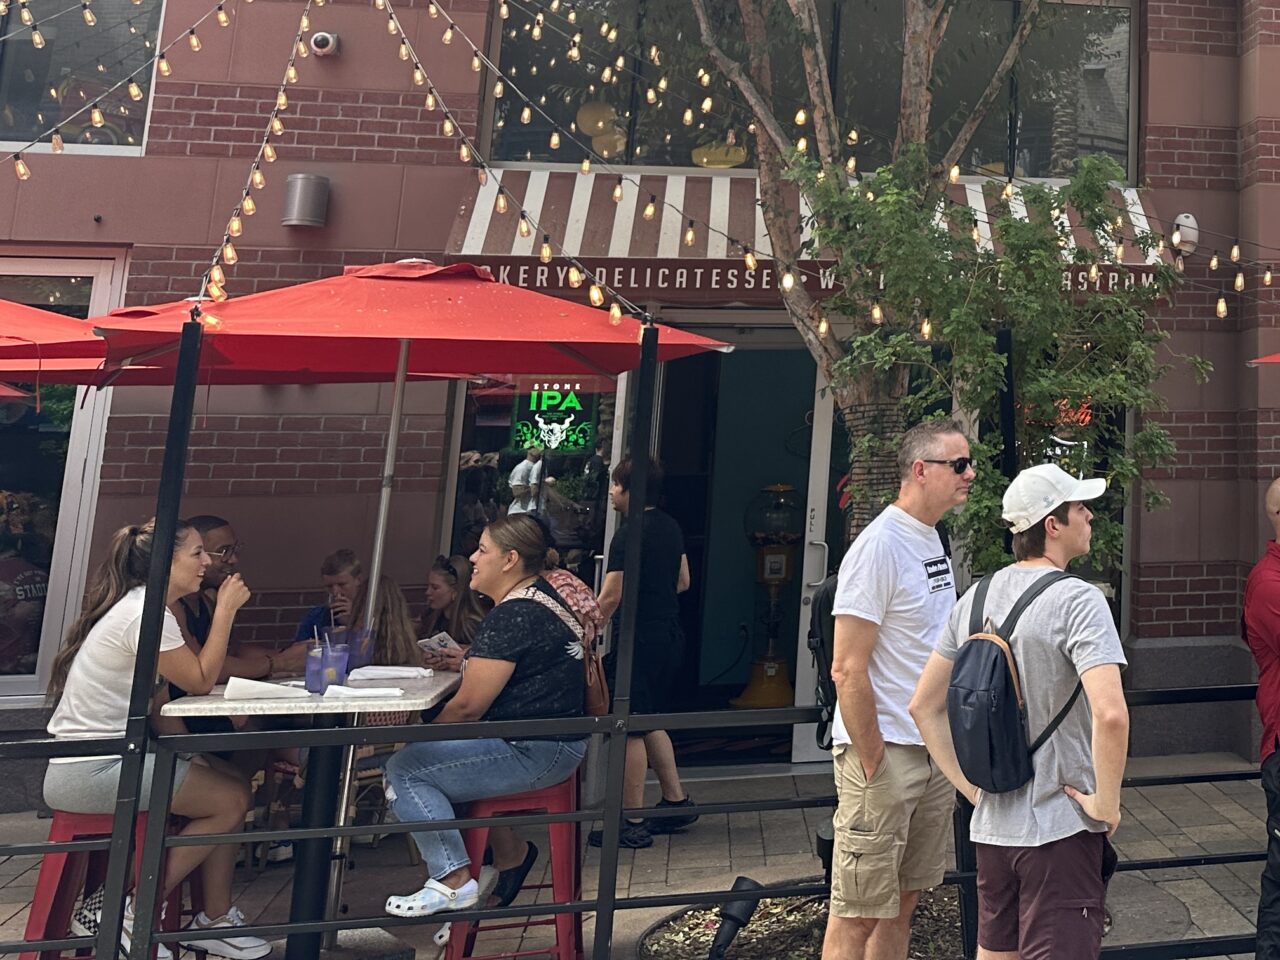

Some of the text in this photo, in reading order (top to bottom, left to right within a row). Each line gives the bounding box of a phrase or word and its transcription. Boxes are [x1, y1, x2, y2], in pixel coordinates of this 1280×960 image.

[480, 264, 569, 288] KERY
[595, 267, 783, 289] DELICATESSE
[529, 390, 584, 411] IPA
